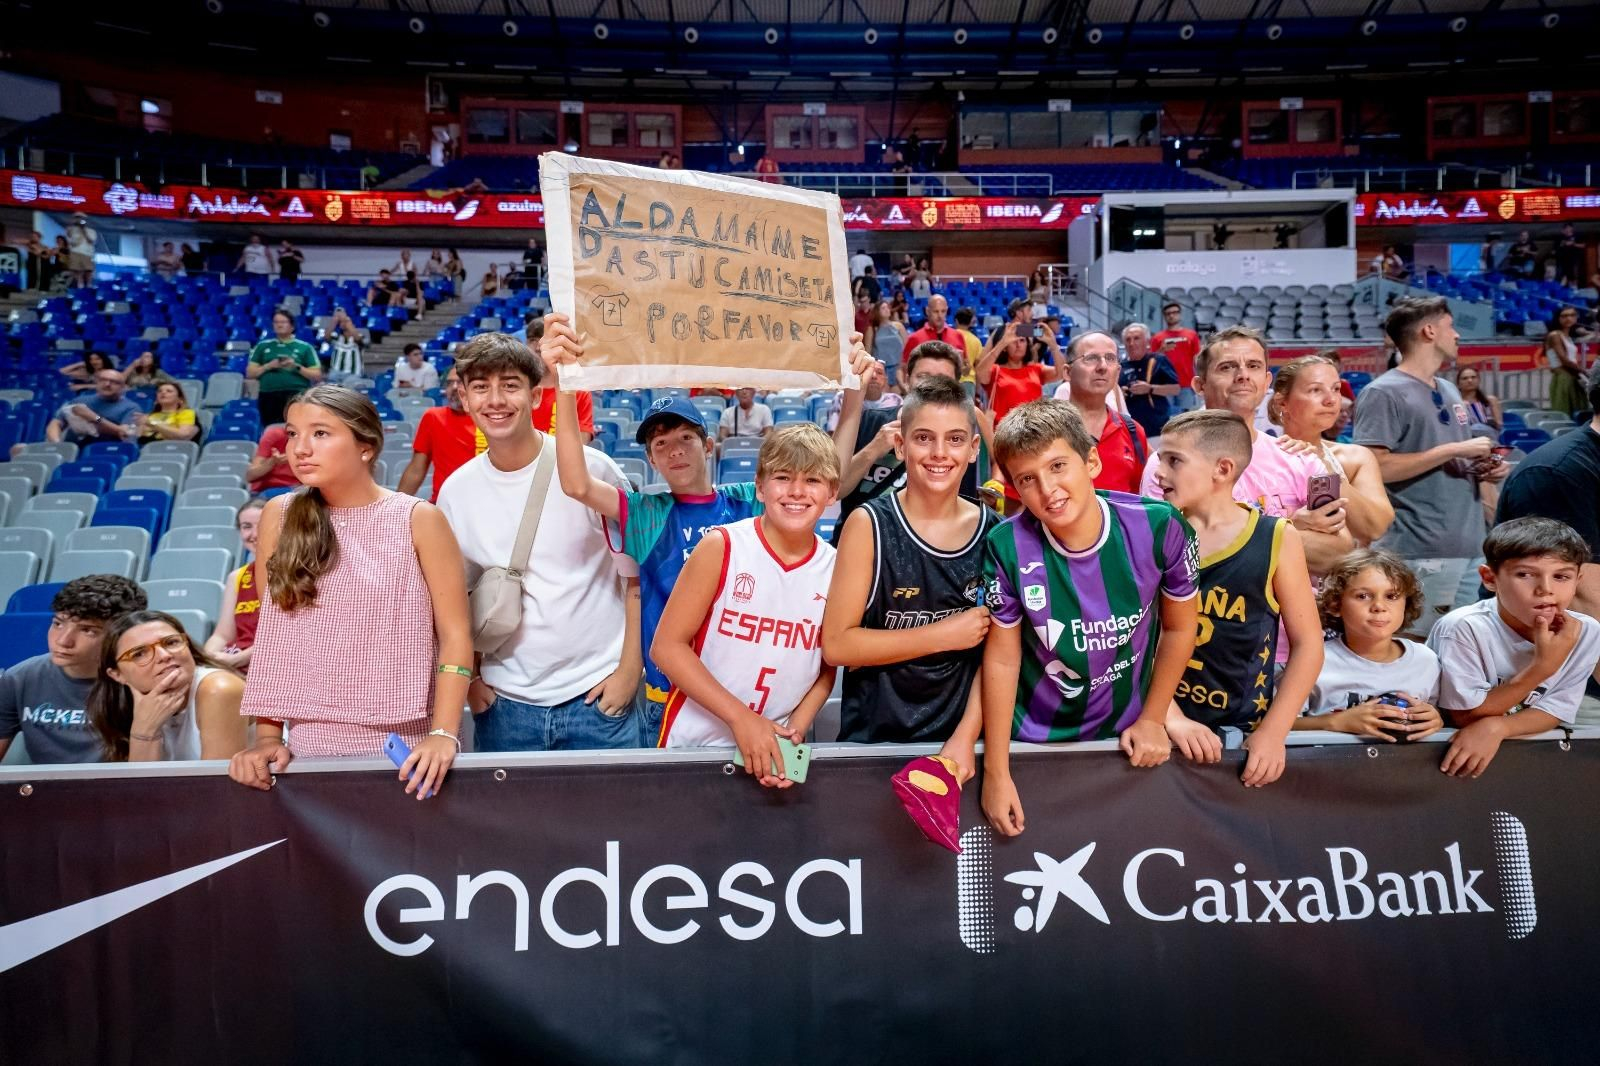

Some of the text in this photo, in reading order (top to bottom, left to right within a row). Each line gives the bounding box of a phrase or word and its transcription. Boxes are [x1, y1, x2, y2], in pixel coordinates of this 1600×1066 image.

[396, 200, 456, 214] IBERIA
[987, 205, 1042, 217] IBERIA
[1113, 660, 1130, 672] DEL
[749, 667, 776, 715] 5
[1122, 841, 1495, 924] CaixaBank
[364, 840, 863, 957] endesa
